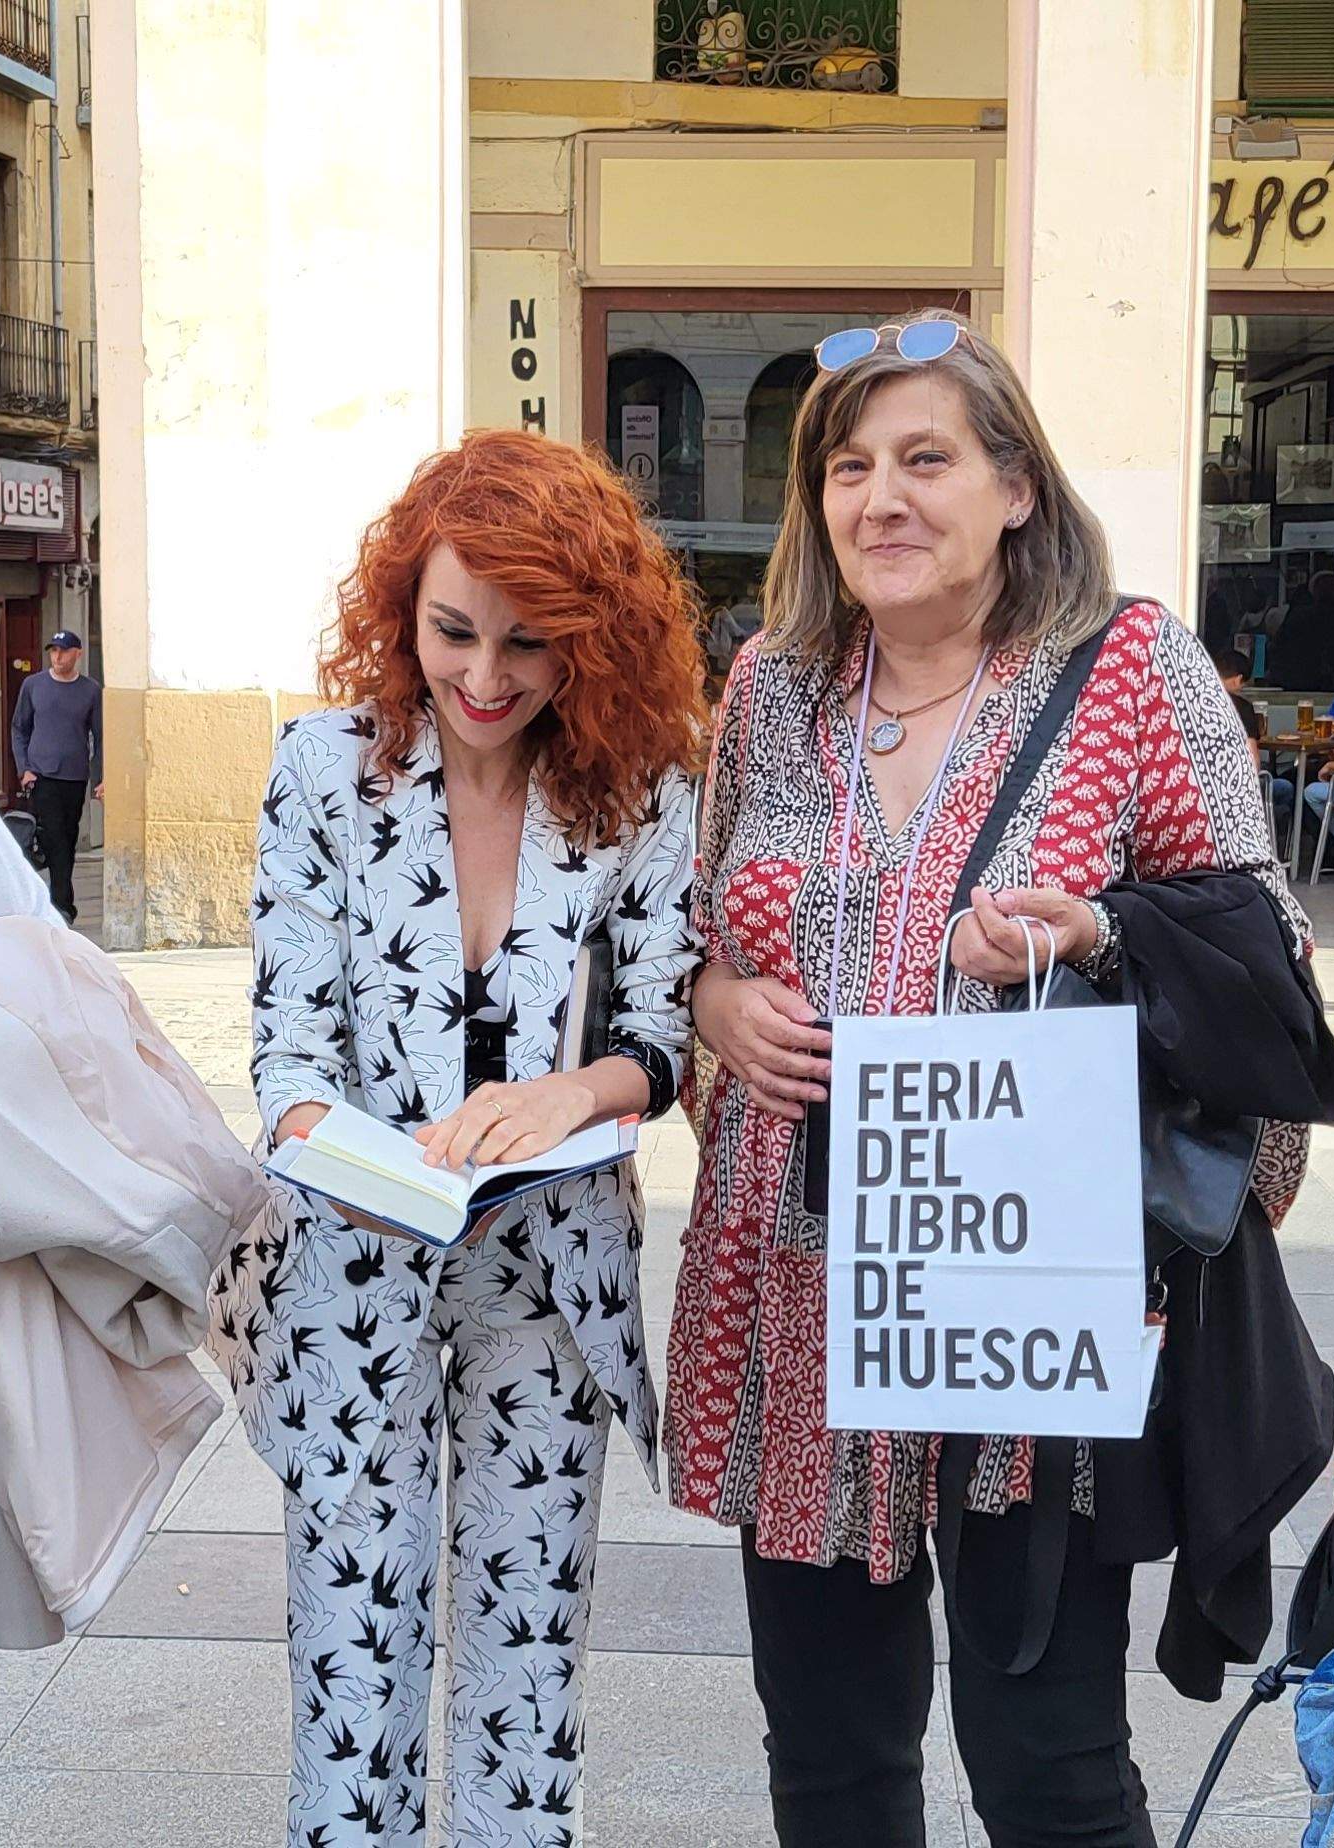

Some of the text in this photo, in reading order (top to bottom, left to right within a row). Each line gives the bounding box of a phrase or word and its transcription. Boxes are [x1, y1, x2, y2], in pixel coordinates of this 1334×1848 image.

[857, 1057, 1026, 1123] FERIA
[855, 1126, 962, 1189] DEL
[854, 1192, 1028, 1255] LIBRO
[853, 1259, 926, 1321] DE
[853, 1327, 1110, 1393] HUESCA
